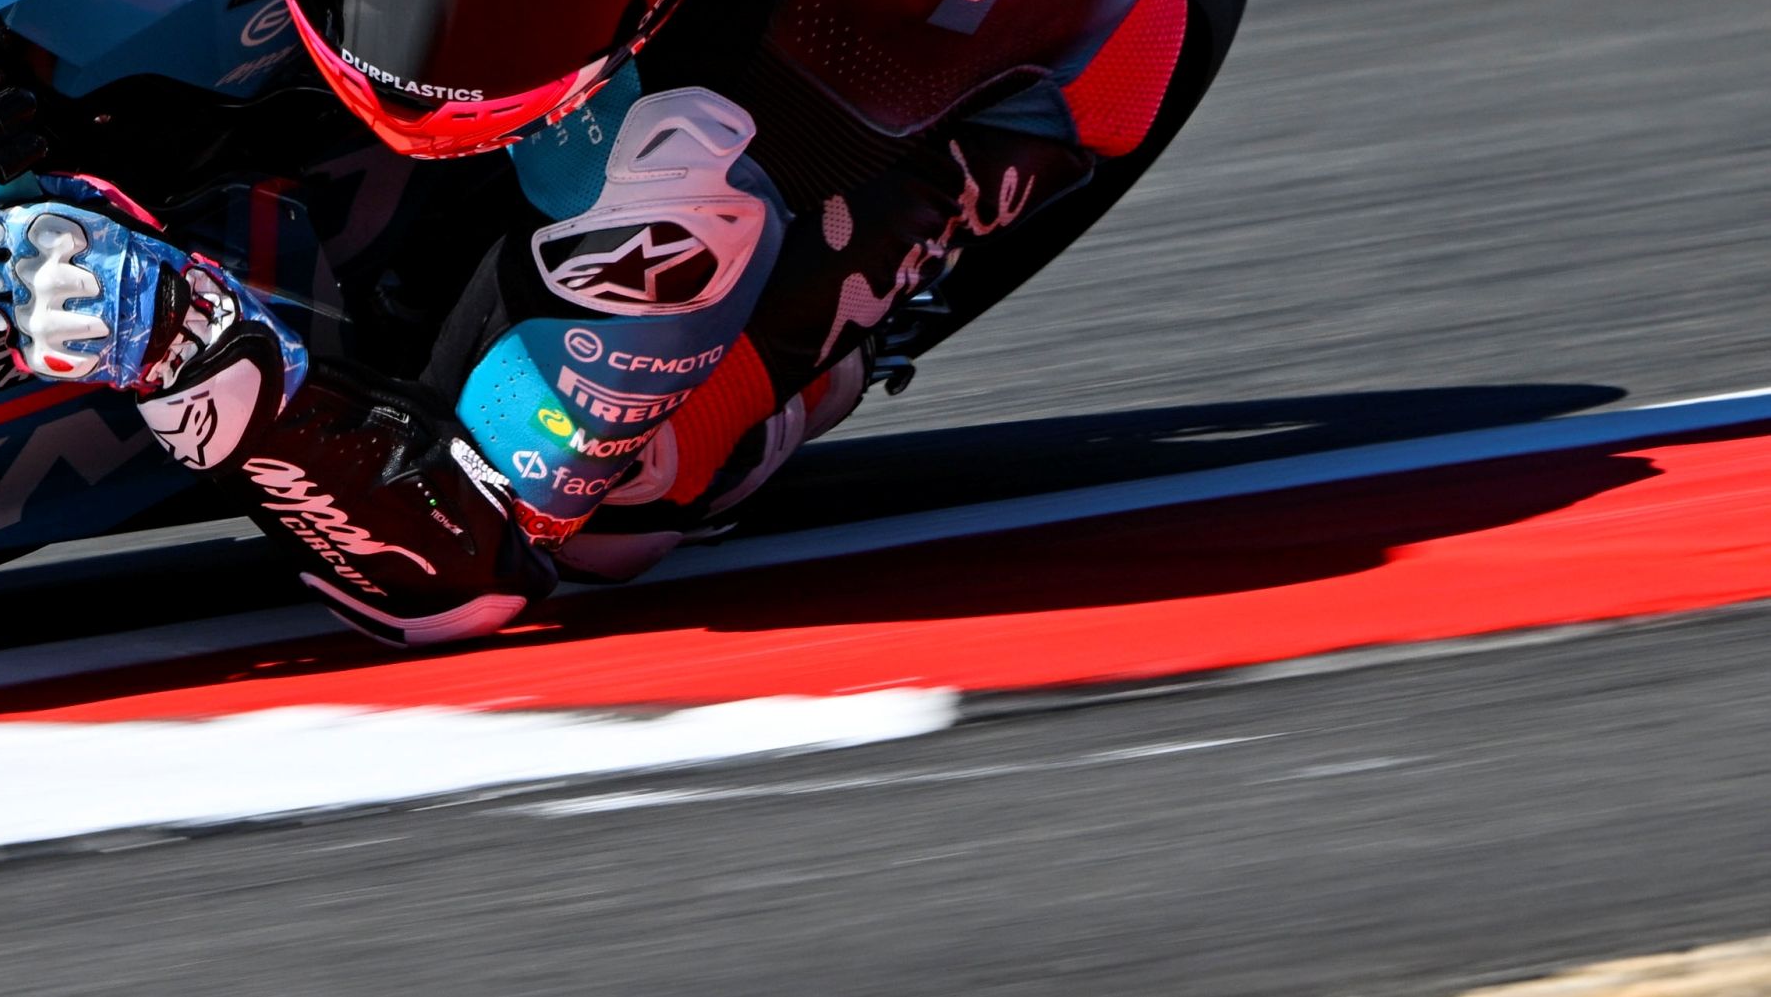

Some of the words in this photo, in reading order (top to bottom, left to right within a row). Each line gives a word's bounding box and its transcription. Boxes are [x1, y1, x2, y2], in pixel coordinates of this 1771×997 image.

[340, 48, 484, 103] DURPLASTICS
[608, 344, 724, 374] CFMOTO
[557, 365, 693, 423] PIRELLI
[280, 516, 387, 597] CIRCUIT
